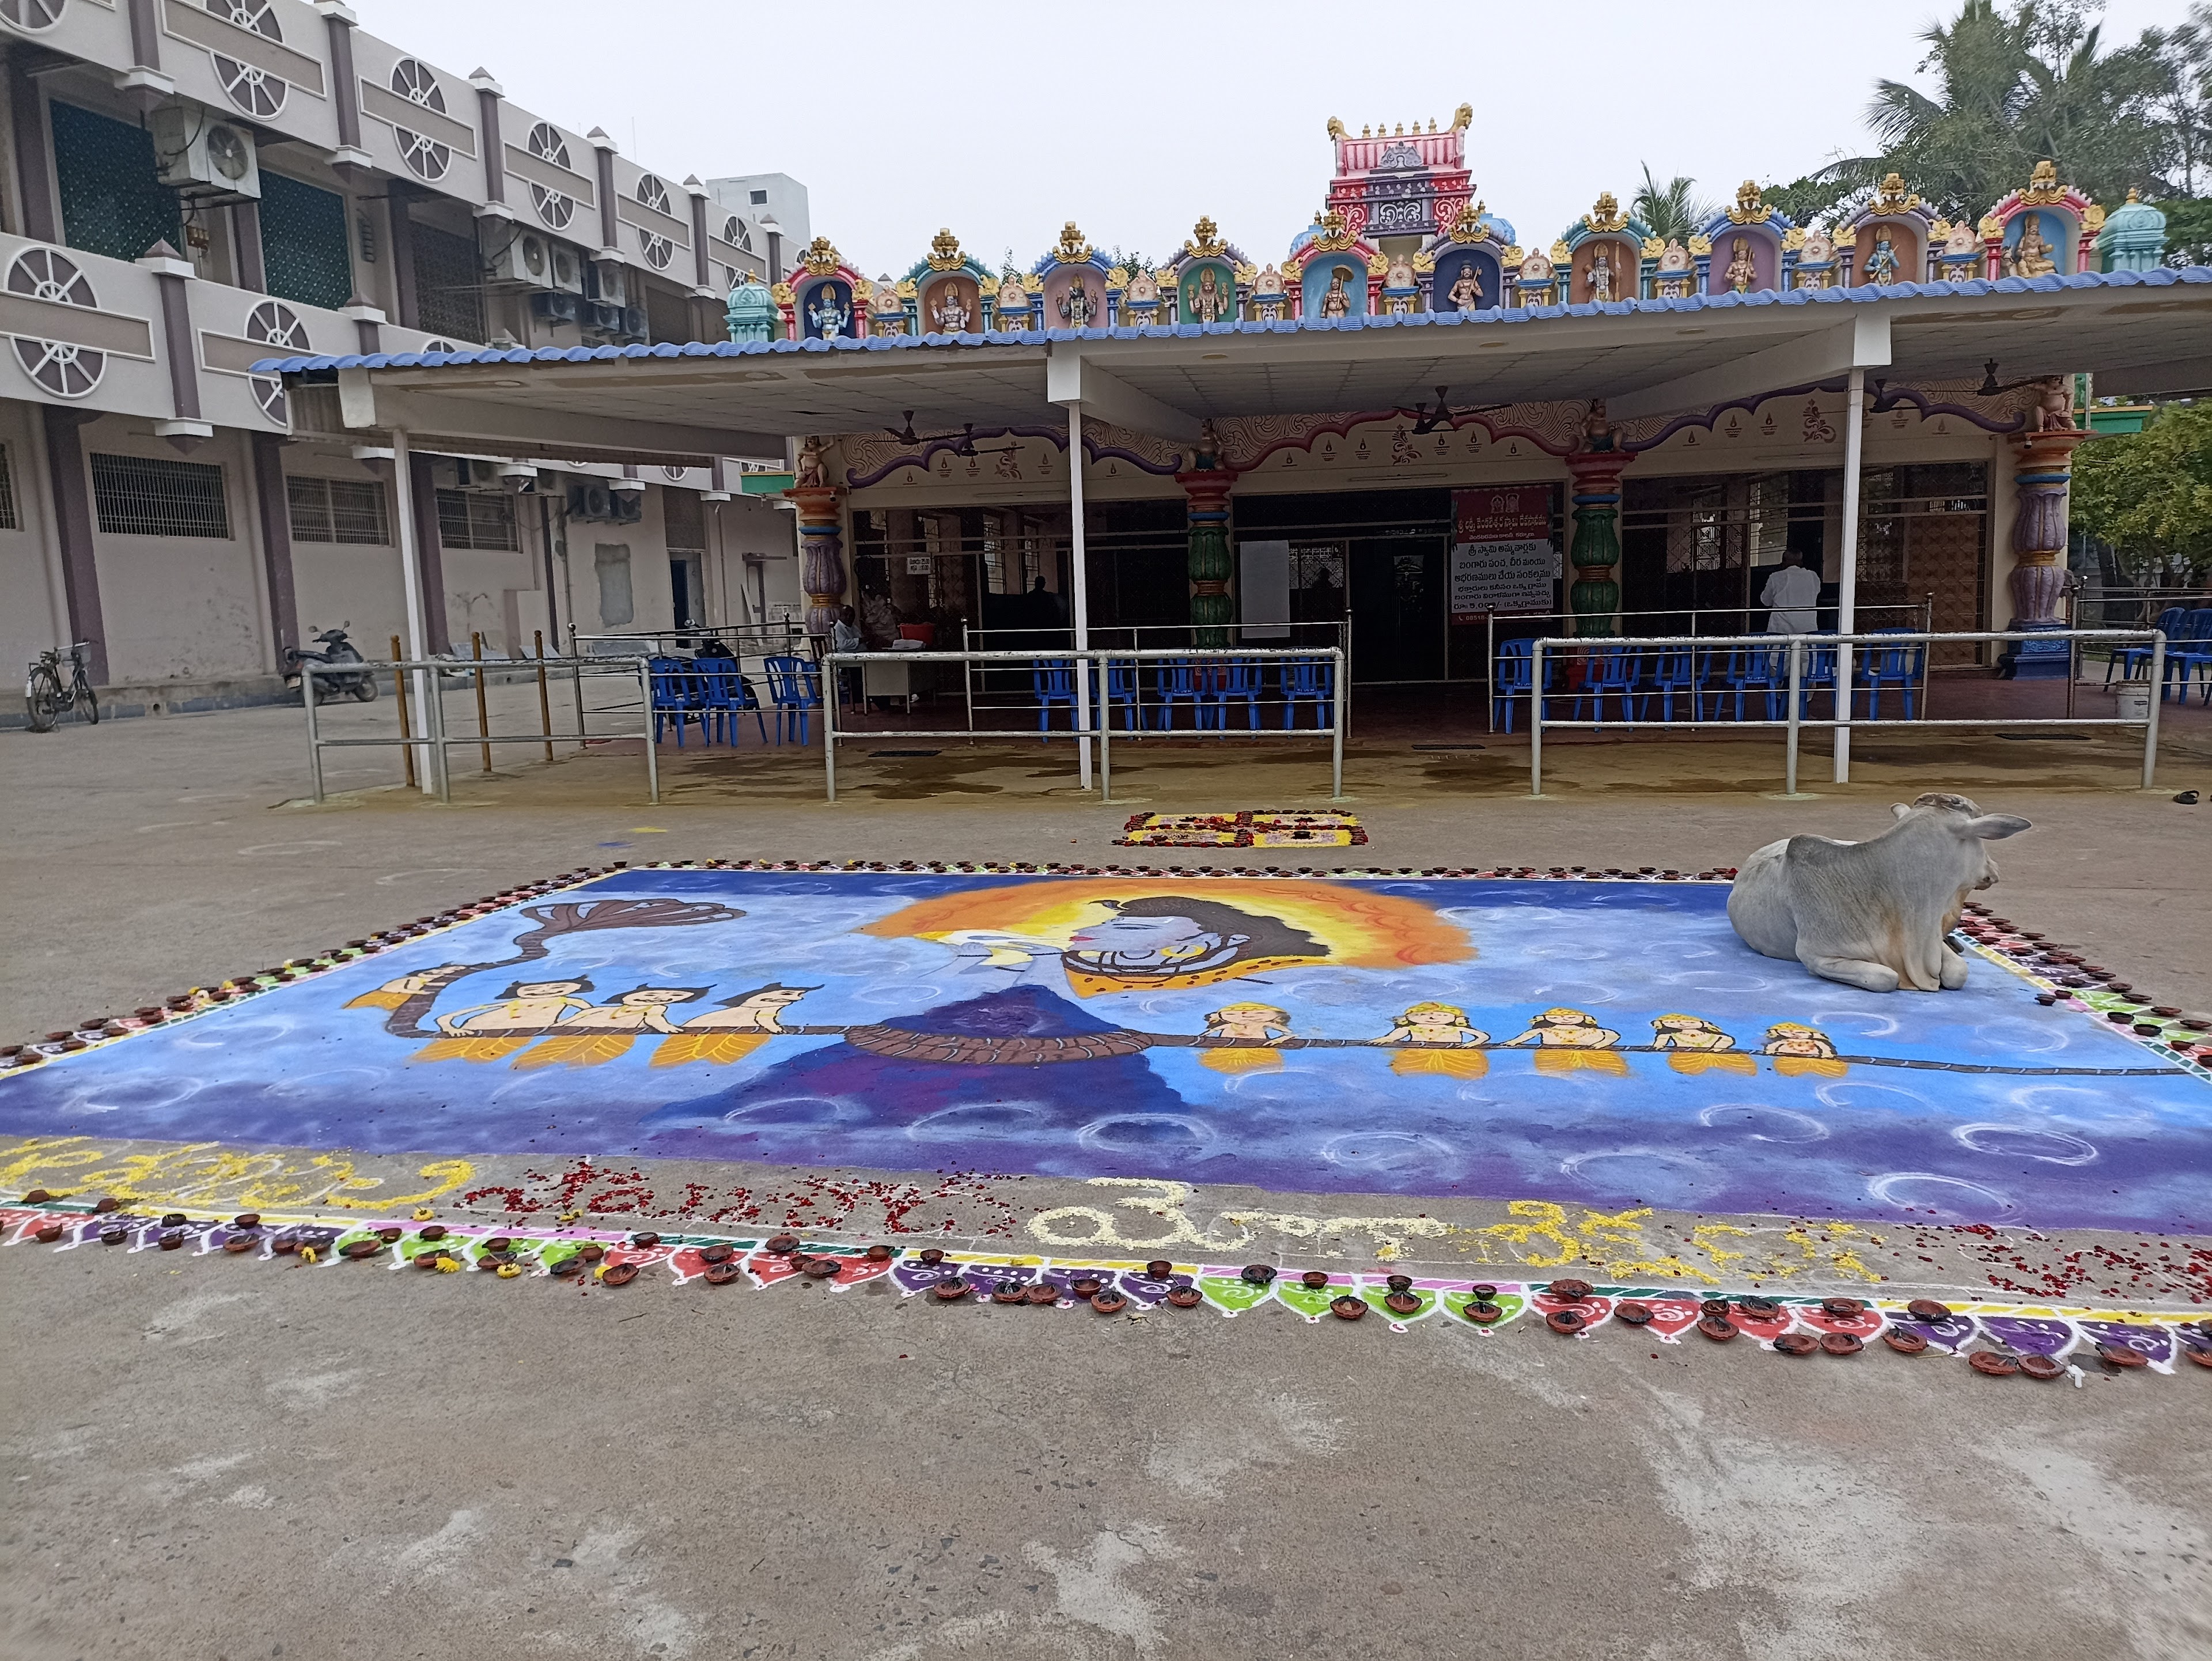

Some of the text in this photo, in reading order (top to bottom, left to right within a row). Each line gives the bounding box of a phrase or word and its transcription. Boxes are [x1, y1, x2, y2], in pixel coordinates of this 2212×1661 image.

[1478, 546, 1497, 555] స్వామి
[1498, 543, 1536, 555] అమ్మవార్లకు
[1460, 560, 1487, 569] బంగారు
[1510, 557, 1521, 566] చీర
[1455, 570, 1550, 582] ఆభరణములు చేయ సంకల్పము
